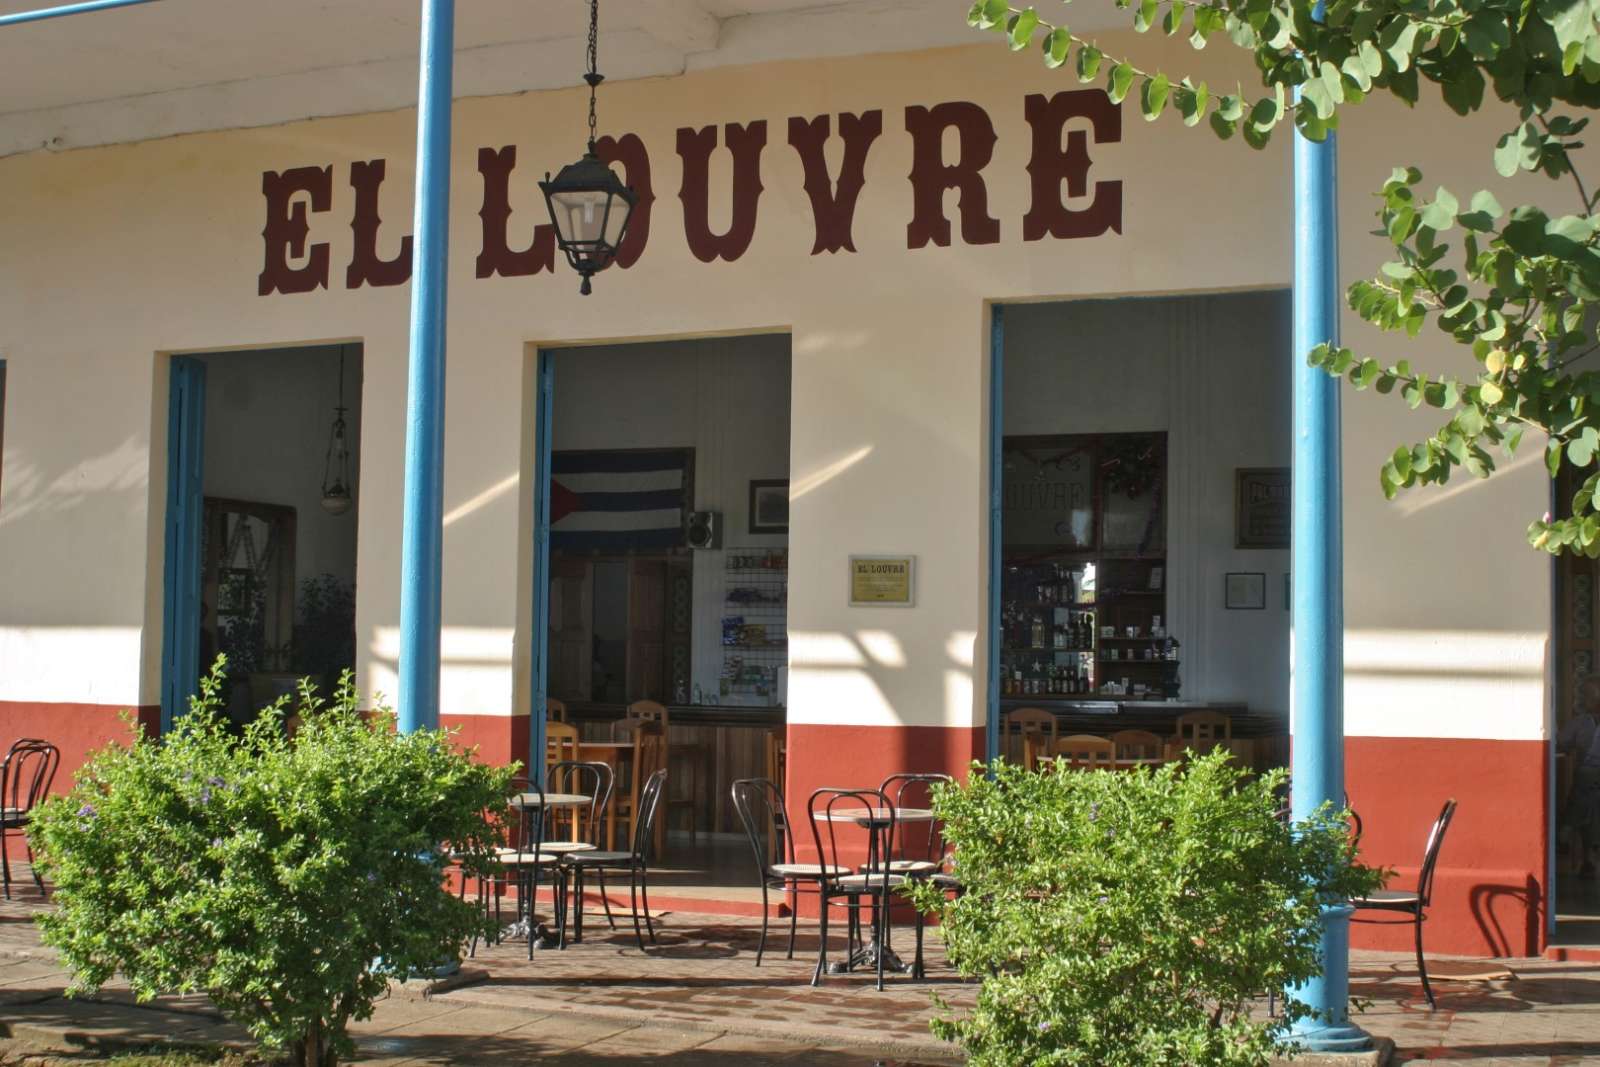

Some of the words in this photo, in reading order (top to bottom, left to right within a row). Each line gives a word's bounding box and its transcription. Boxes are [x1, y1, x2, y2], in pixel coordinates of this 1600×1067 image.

[258, 159, 414, 296] EL
[475, 88, 1123, 279] LOUVRE
[857, 564, 868, 574] EL
